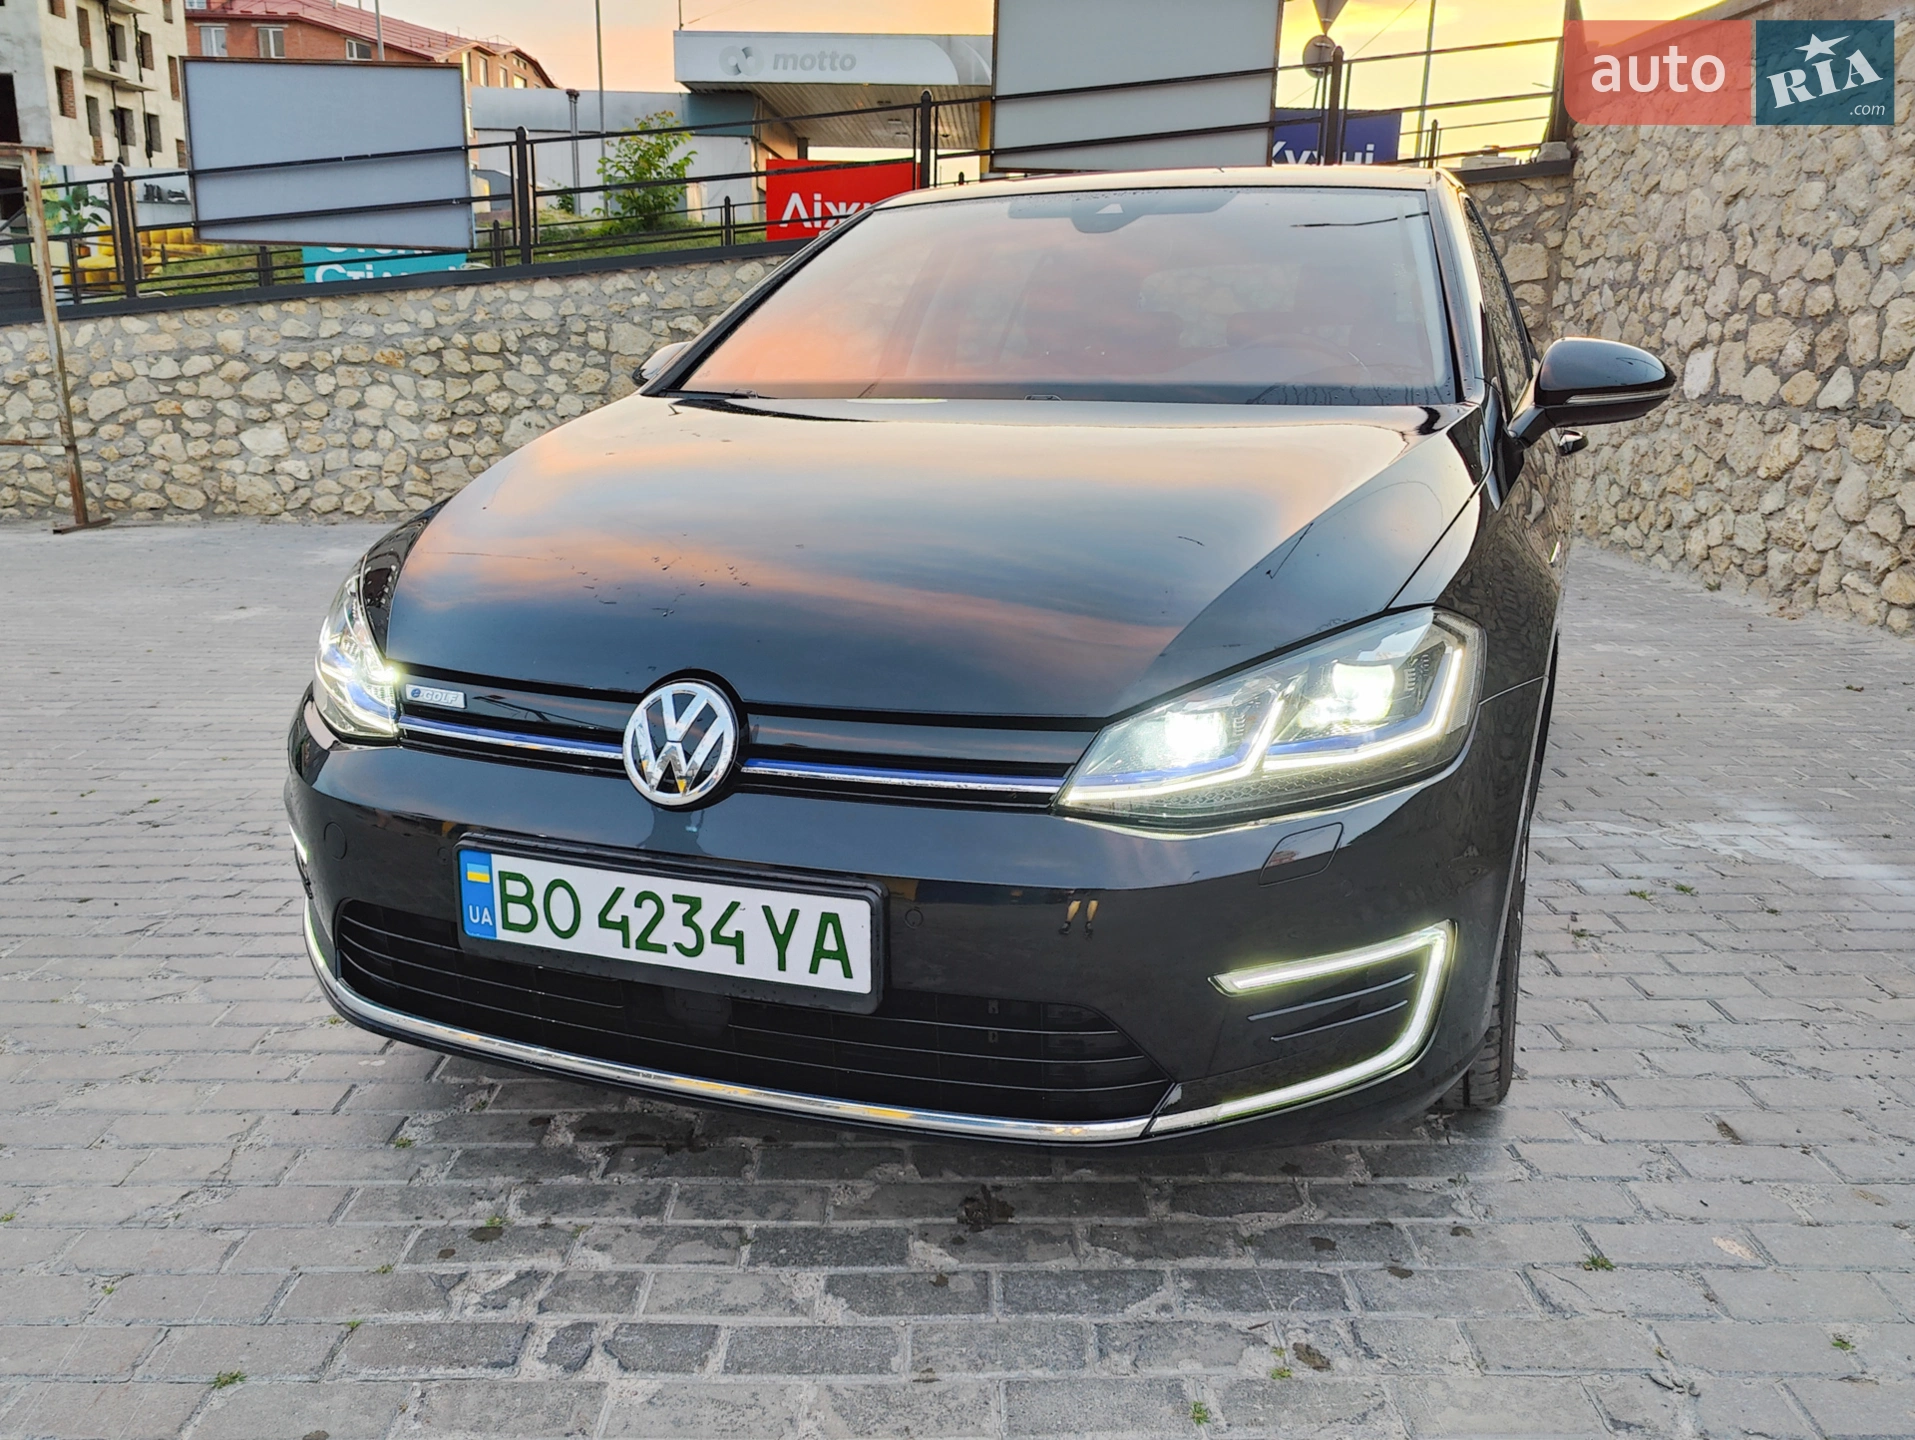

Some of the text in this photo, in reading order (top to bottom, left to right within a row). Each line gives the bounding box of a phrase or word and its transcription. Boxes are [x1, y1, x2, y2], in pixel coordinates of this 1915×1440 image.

[772, 51, 857, 71] motto
[468, 905, 493, 926] UA
[498, 870, 853, 980] BO 4234 YA
